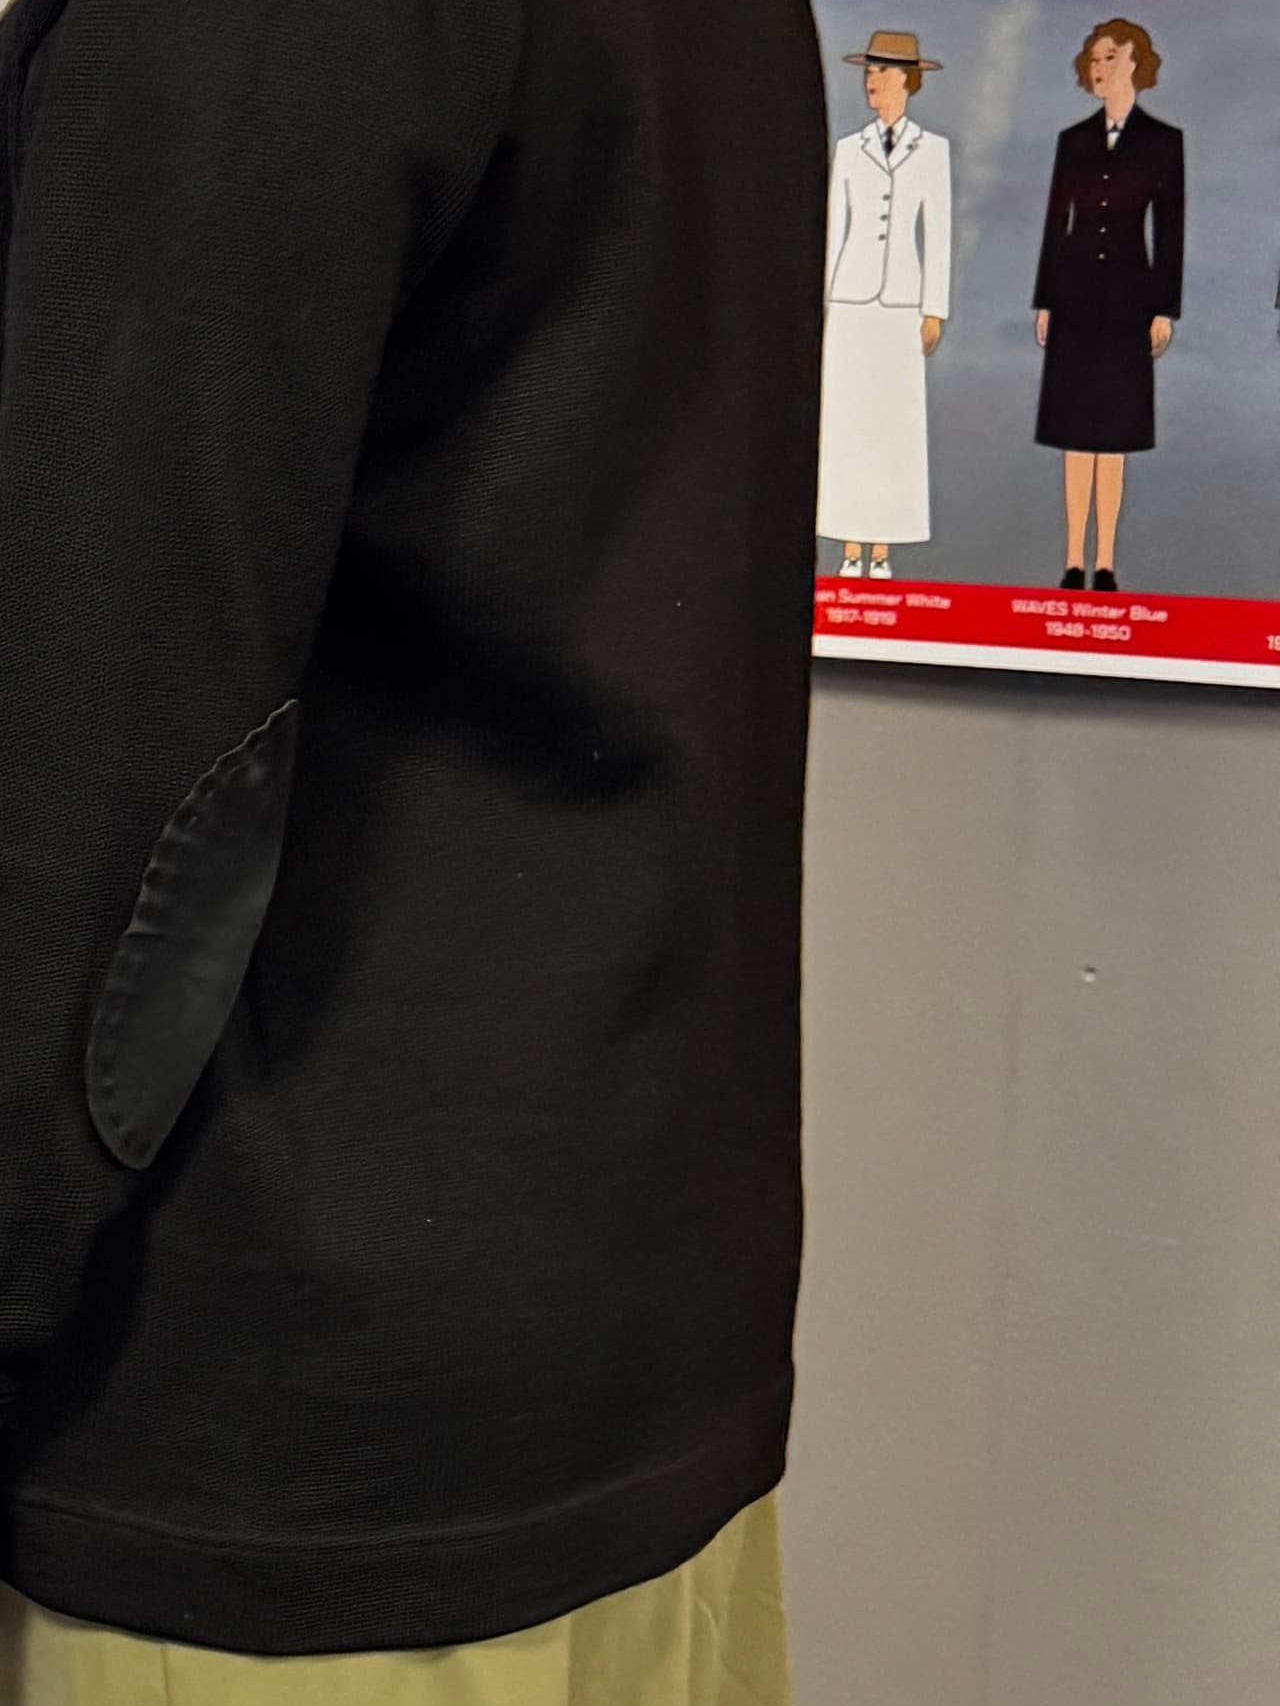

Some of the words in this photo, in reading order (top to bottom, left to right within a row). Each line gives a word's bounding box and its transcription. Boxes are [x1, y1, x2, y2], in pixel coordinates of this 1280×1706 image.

[837, 587, 903, 606] Summer
[905, 592, 952, 610] White
[1011, 598, 1069, 618] WAVES
[1071, 601, 1128, 620] Winter
[1128, 604, 1169, 623] Blue
